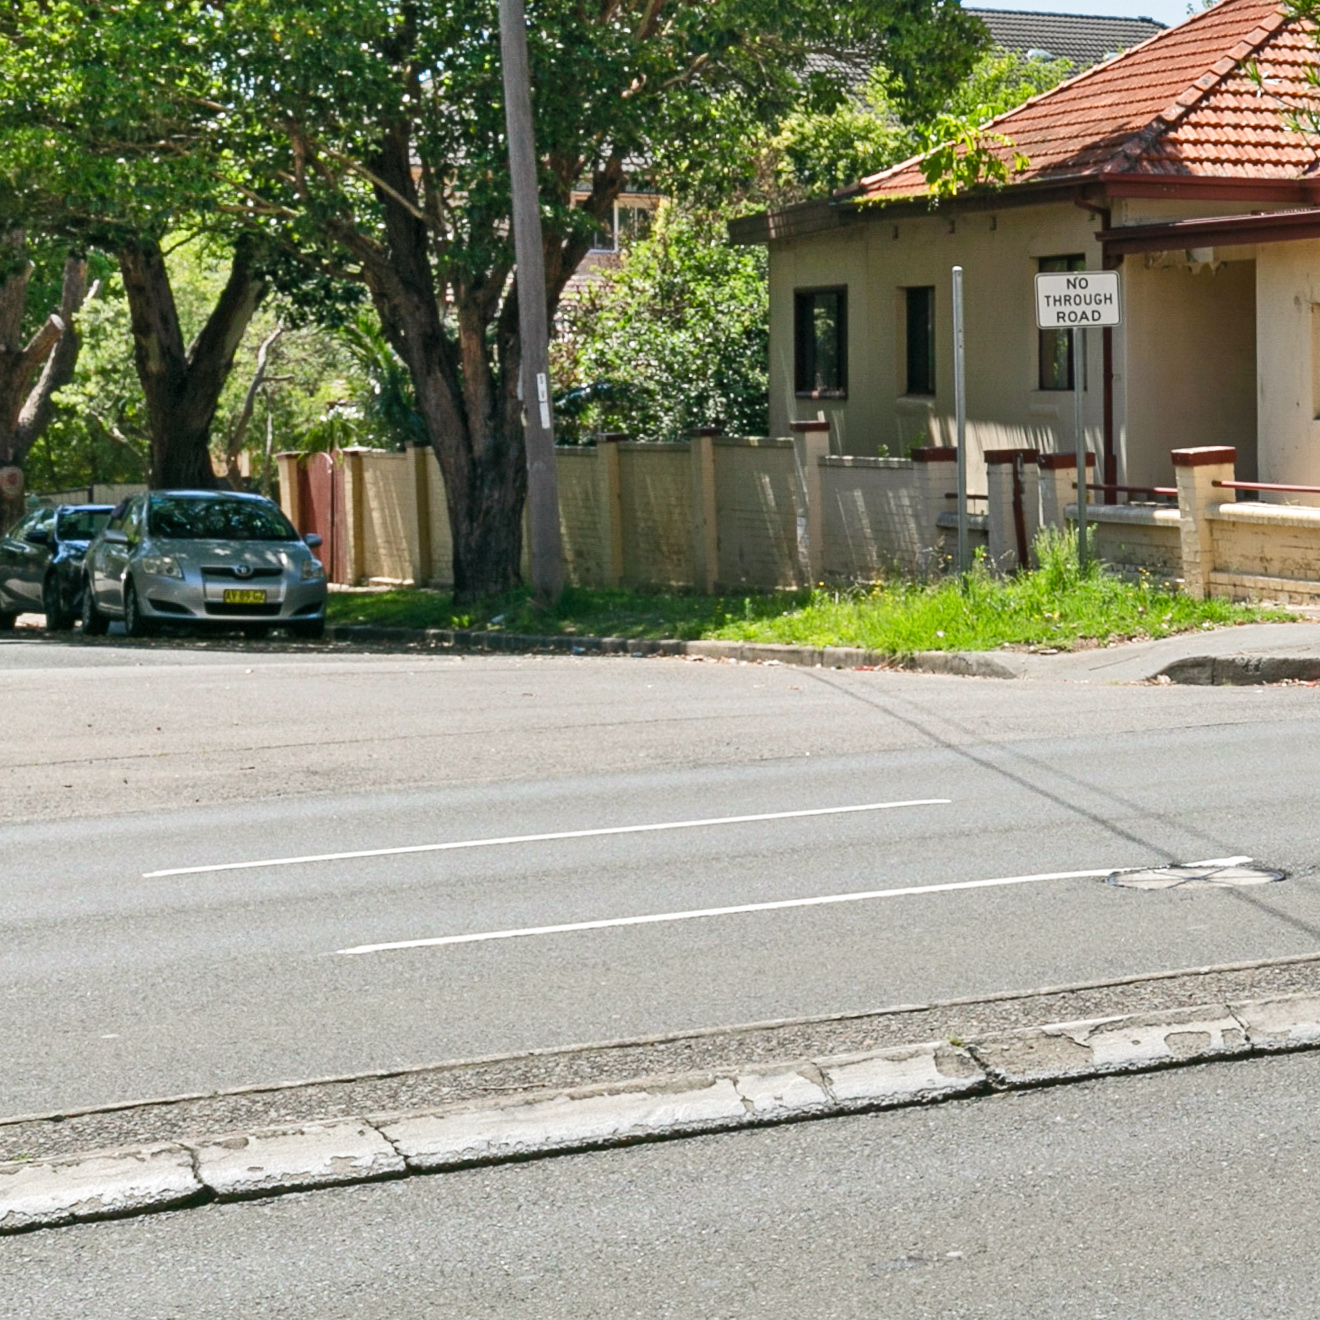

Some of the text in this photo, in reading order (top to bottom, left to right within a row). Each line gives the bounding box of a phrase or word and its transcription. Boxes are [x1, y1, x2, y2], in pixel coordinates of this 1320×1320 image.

[1066, 277, 1088, 289] NO
[1044, 293, 1112, 307] THROUGH
[1056, 310, 1101, 323] ROAD
